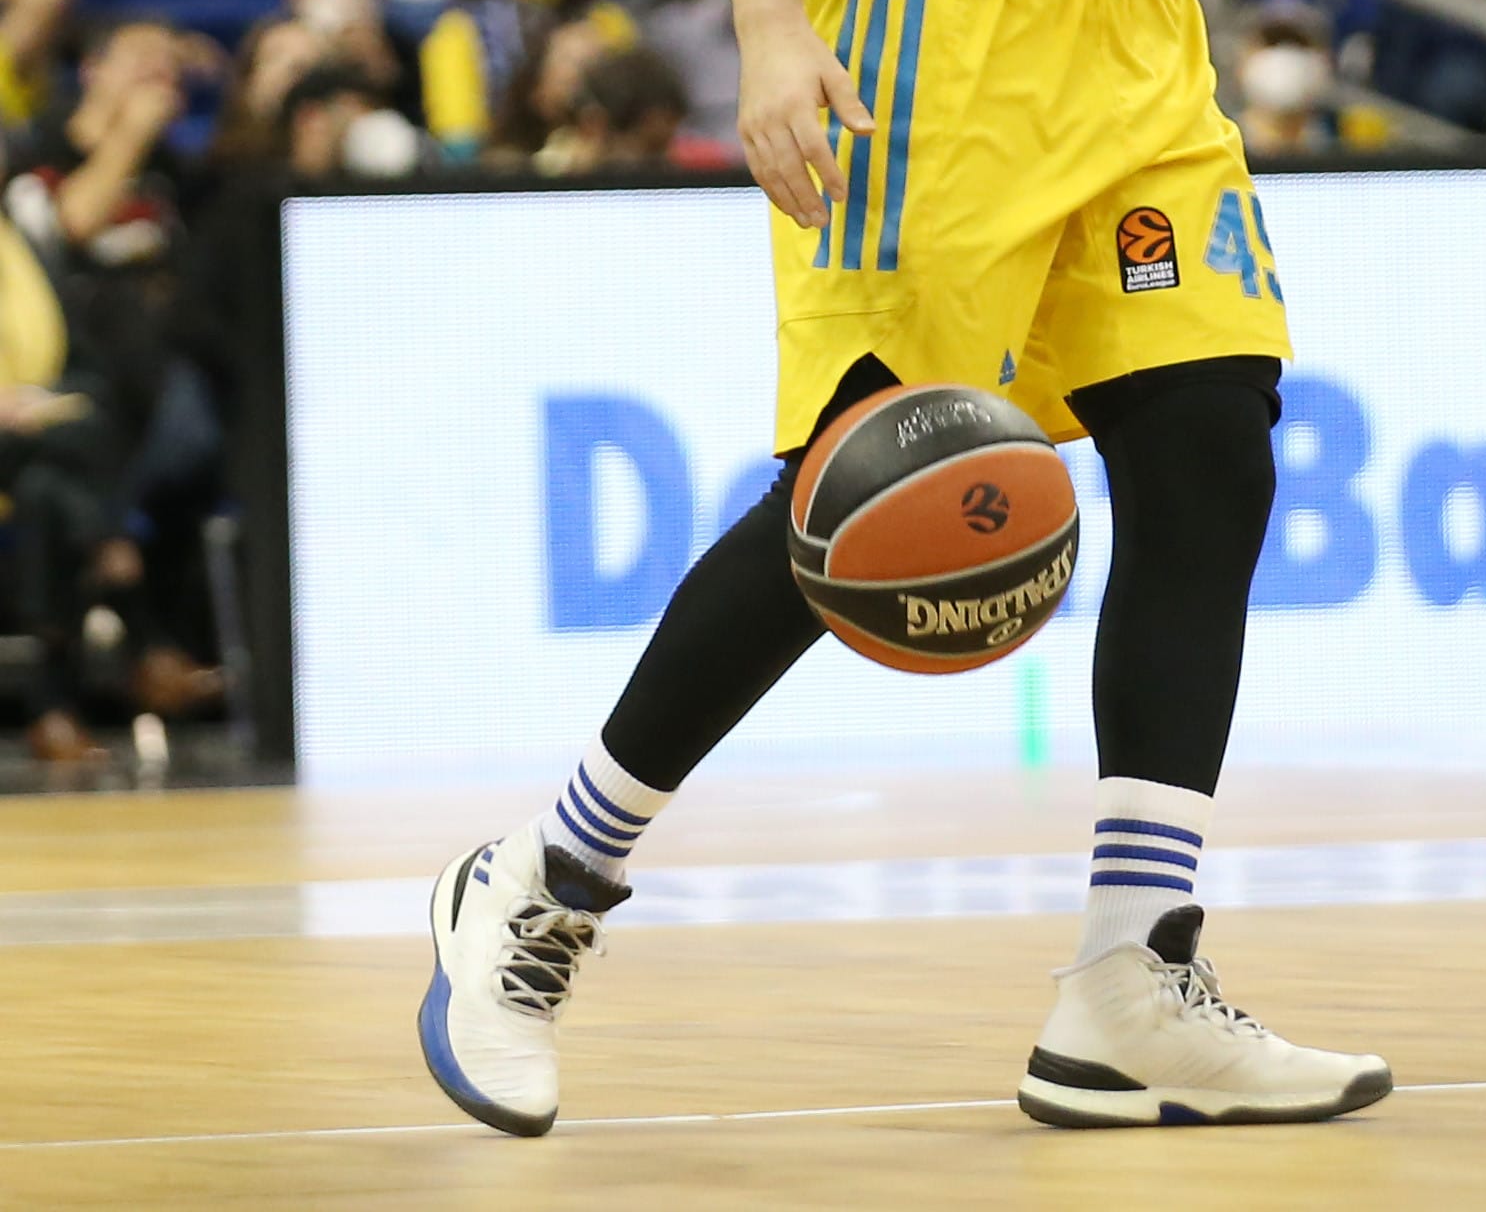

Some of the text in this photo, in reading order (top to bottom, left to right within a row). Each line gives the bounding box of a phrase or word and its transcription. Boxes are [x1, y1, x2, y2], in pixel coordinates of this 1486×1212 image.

[1125, 260, 1174, 277] TURKISH
[1126, 269, 1175, 284] AIRLINES
[905, 543, 1073, 637] SPALDING
